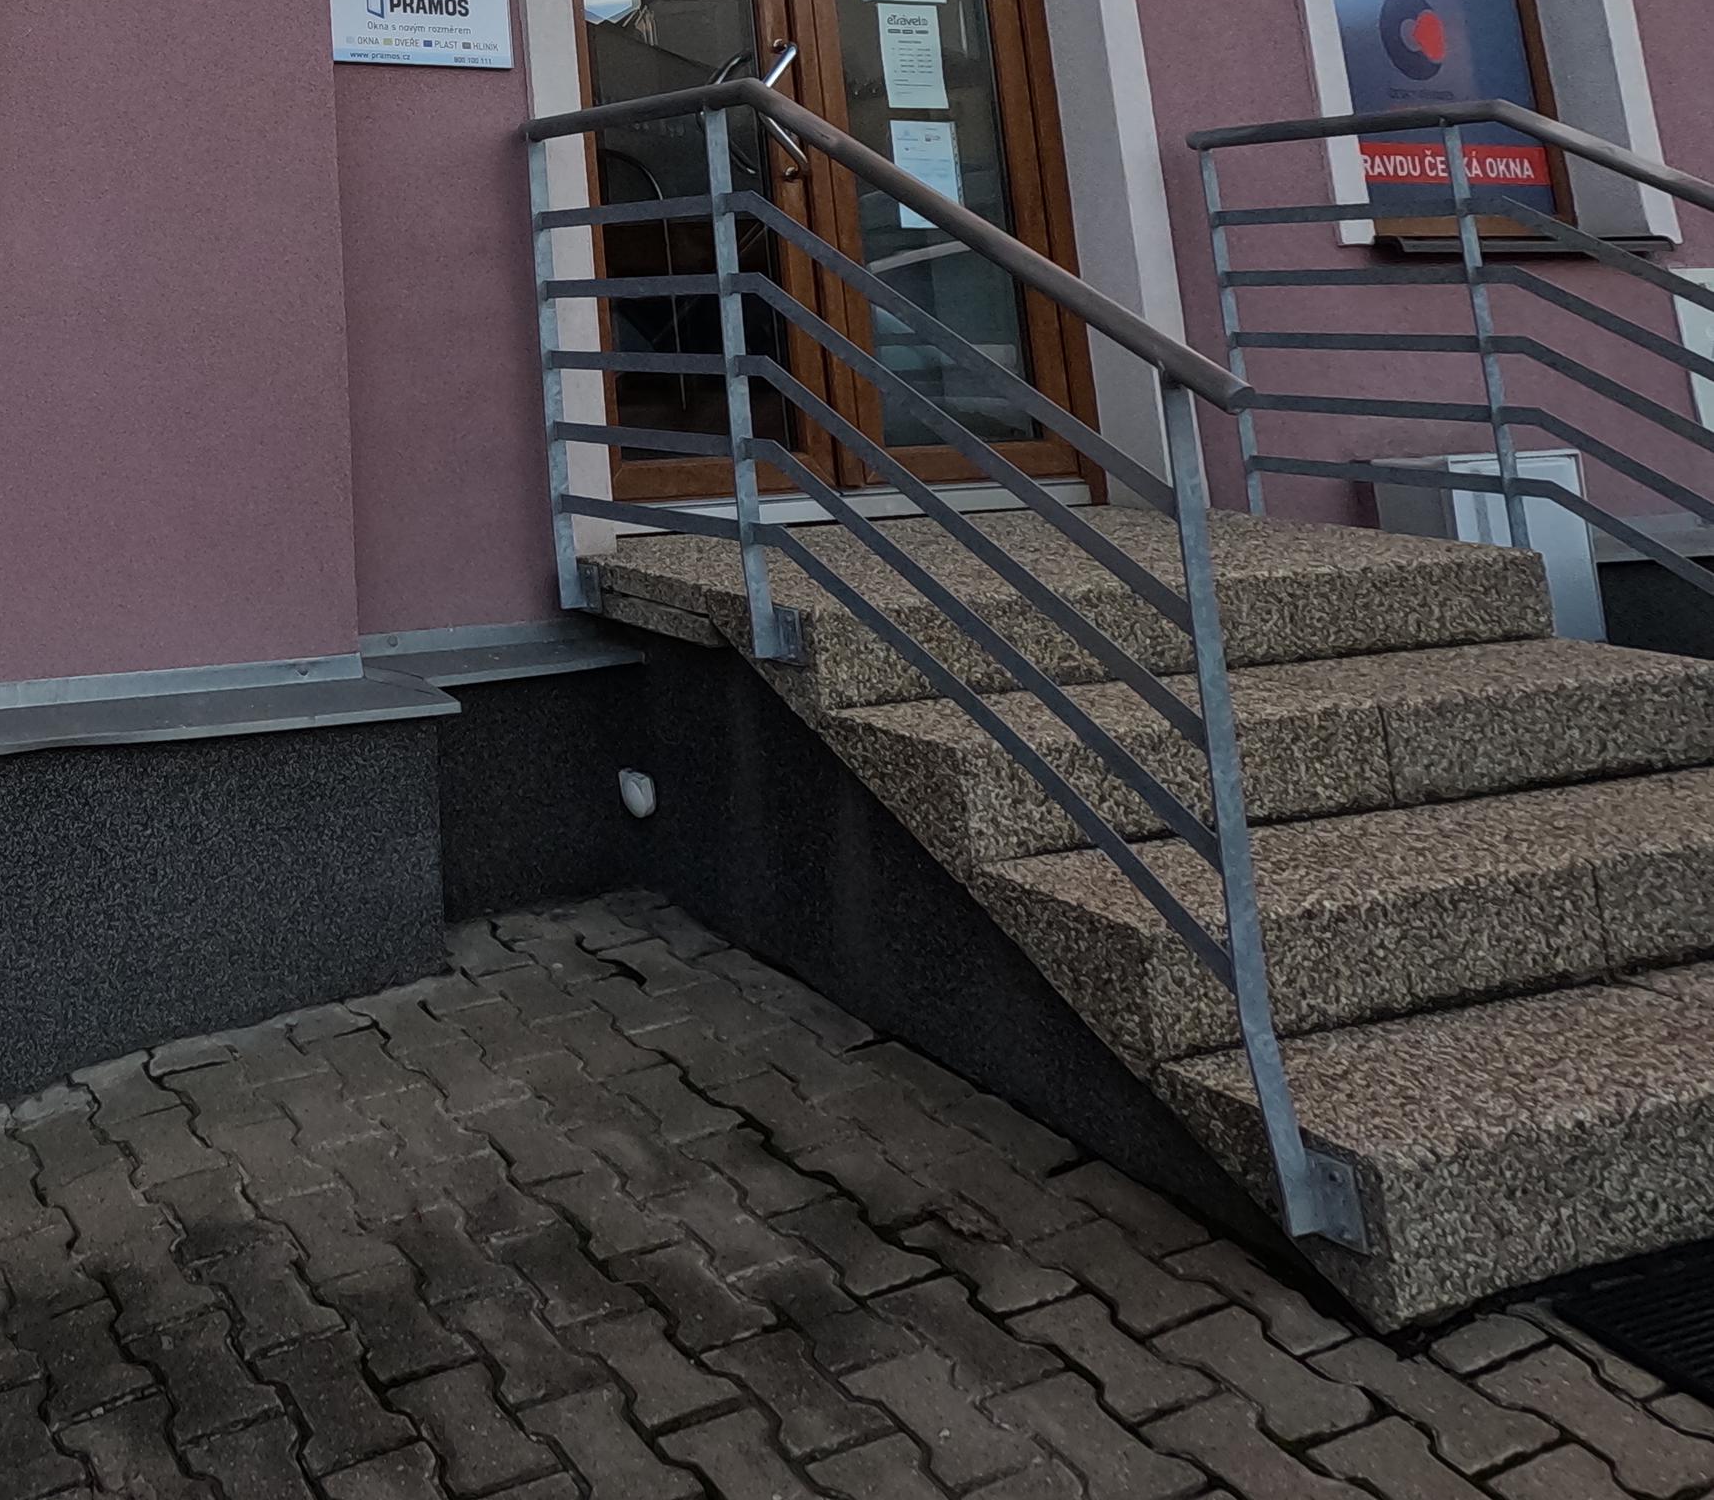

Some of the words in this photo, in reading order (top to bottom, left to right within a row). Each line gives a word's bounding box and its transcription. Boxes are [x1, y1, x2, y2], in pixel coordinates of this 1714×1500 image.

[1362, 153, 1421, 177] RAVDU
[1424, 150, 1484, 178] ČEKÁ
[1486, 157, 1535, 179] OKNA
